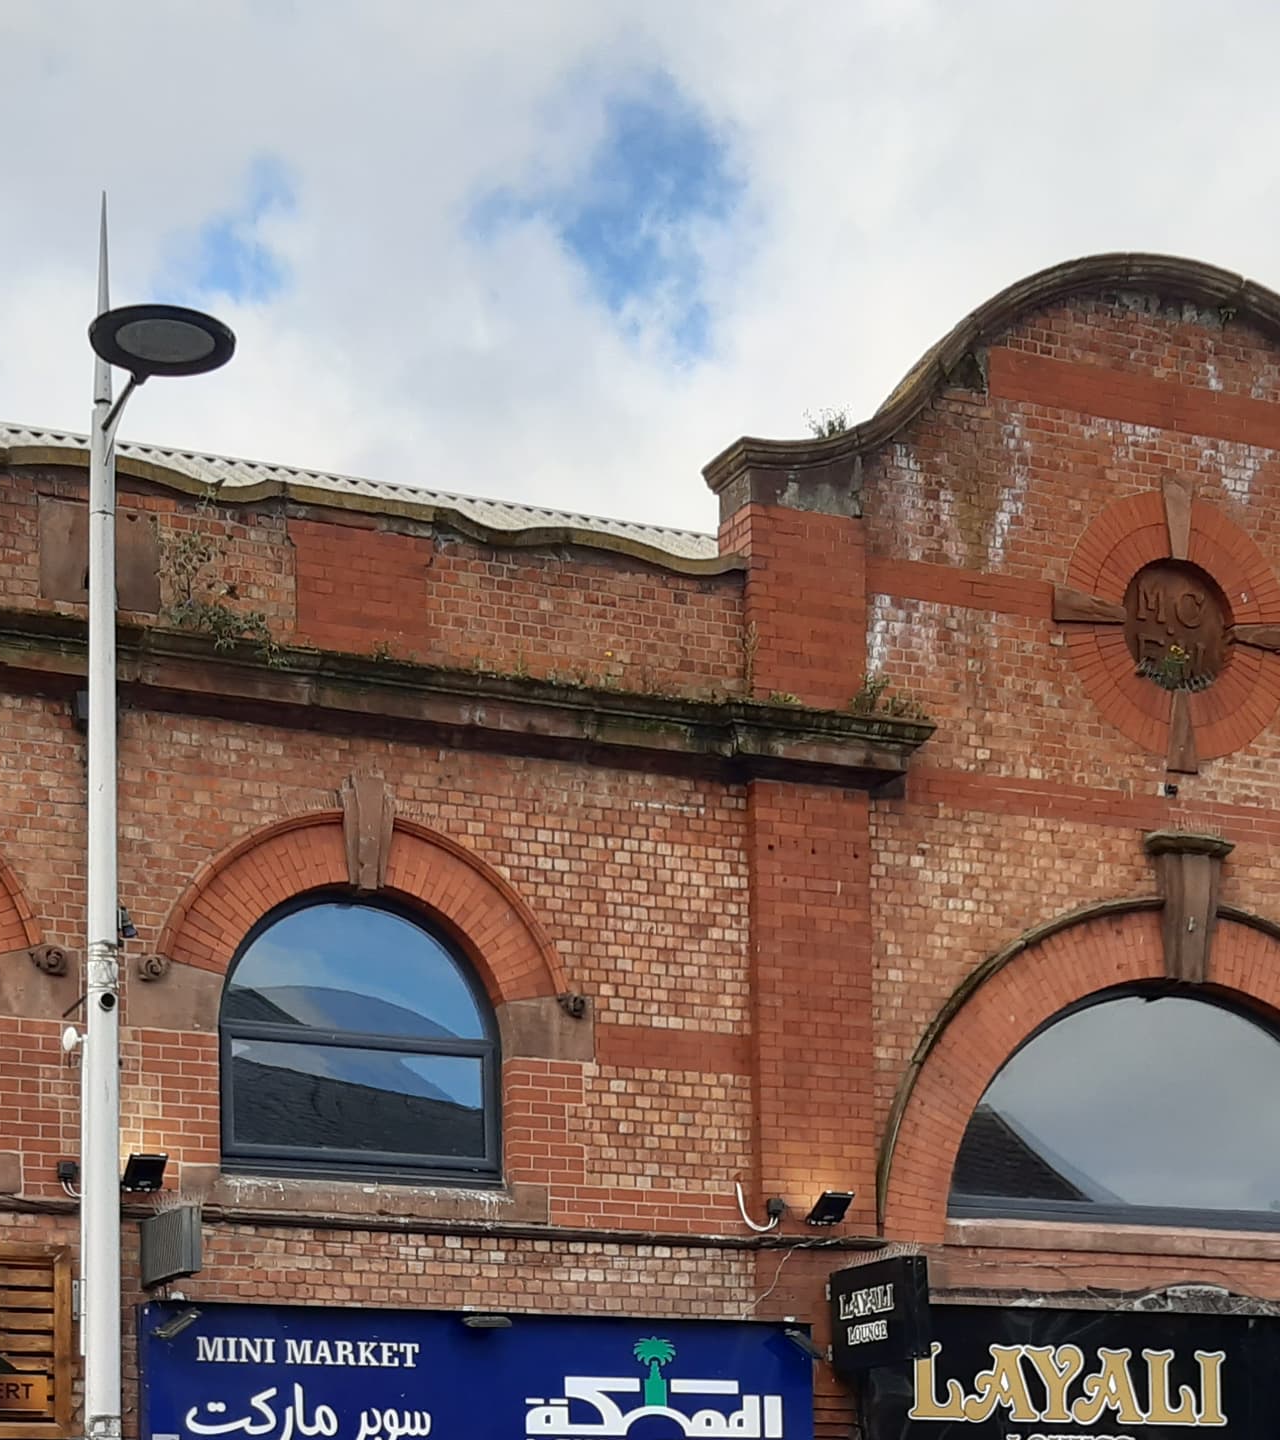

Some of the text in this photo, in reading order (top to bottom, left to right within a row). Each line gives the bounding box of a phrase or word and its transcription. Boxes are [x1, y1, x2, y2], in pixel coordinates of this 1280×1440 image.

[839, 1283, 895, 1320] LAYALI
[847, 1319, 888, 1345] LOUNGE
[196, 1335, 419, 1368] MINI MARKET
[908, 1341, 1228, 1427] LAYALI
